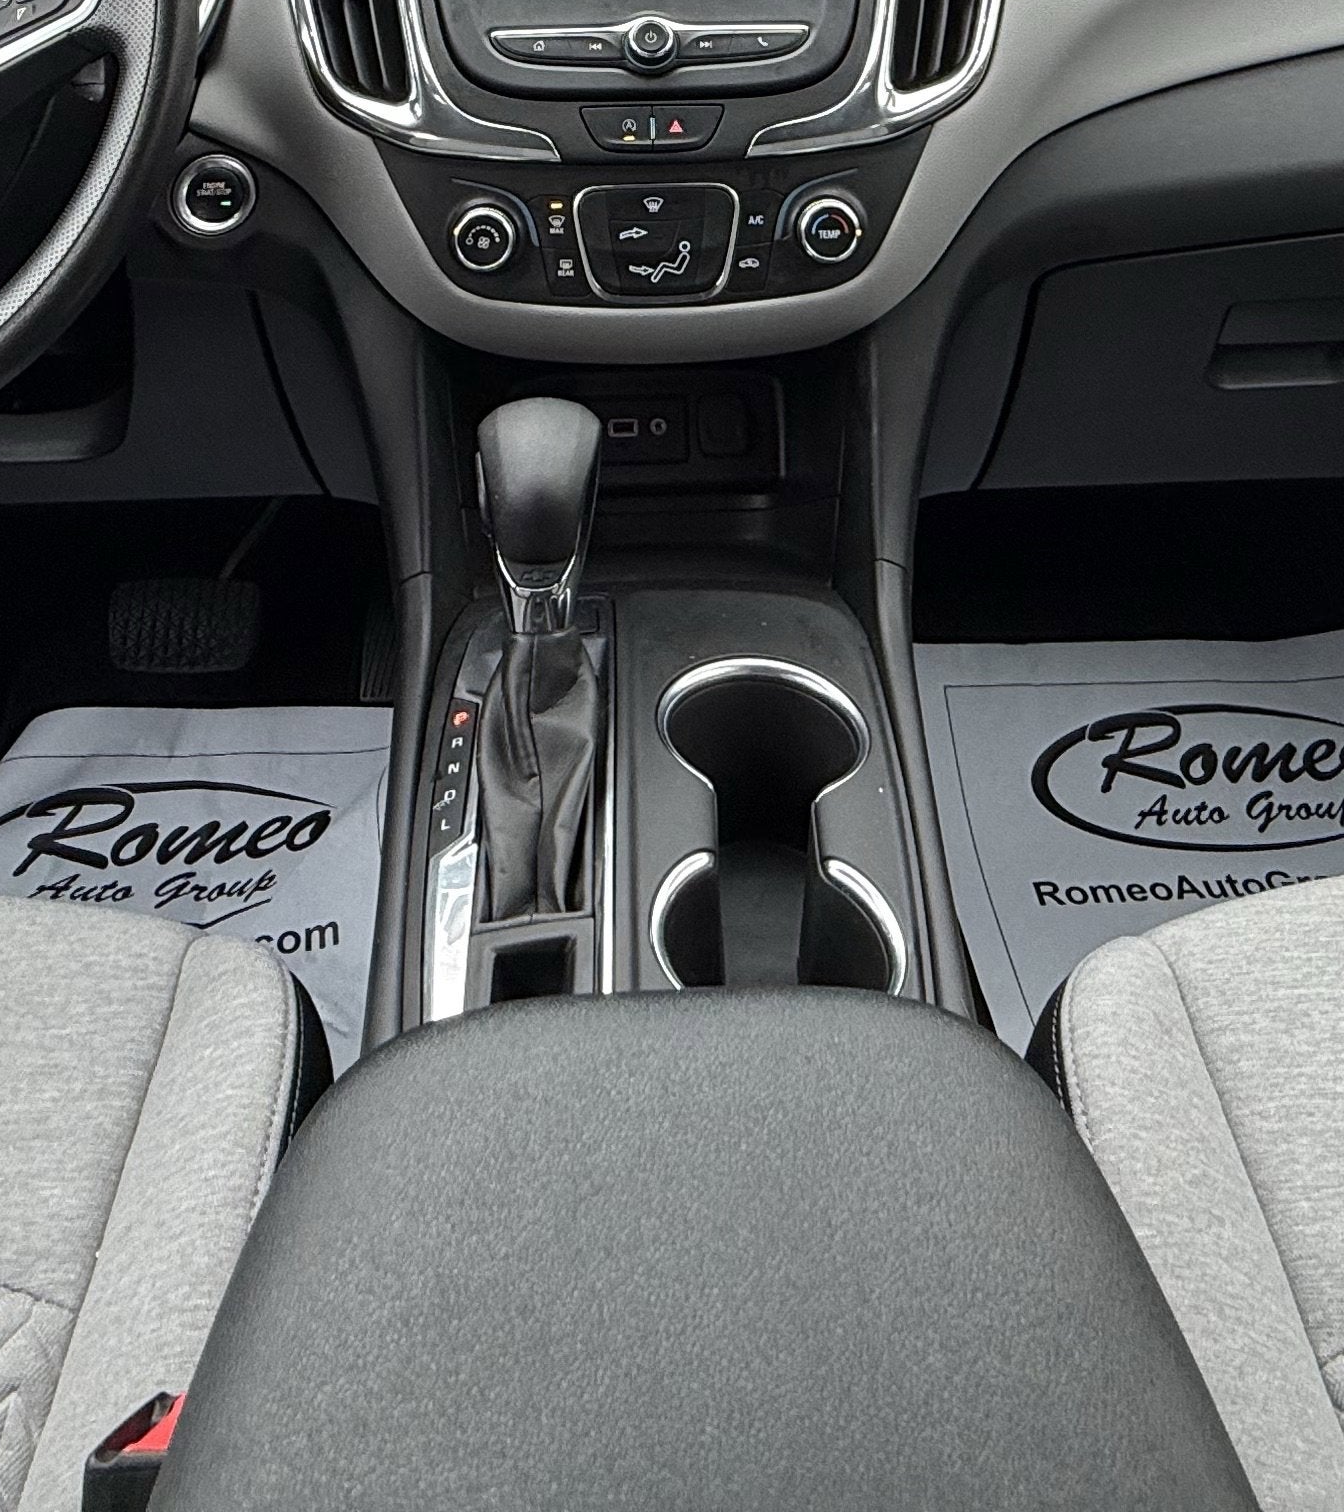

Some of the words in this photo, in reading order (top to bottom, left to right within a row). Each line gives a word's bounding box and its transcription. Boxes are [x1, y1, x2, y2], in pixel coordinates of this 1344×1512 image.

[748, 214, 764, 226] A/C
[818, 229, 841, 240] TEMP
[447, 761, 460, 775] N
[1134, 793, 1230, 829] Auto
[12, 787, 331, 877] Romeo
[440, 819, 451, 831] L
[27, 873, 134, 902] Auto
[154, 869, 277, 909] Group
